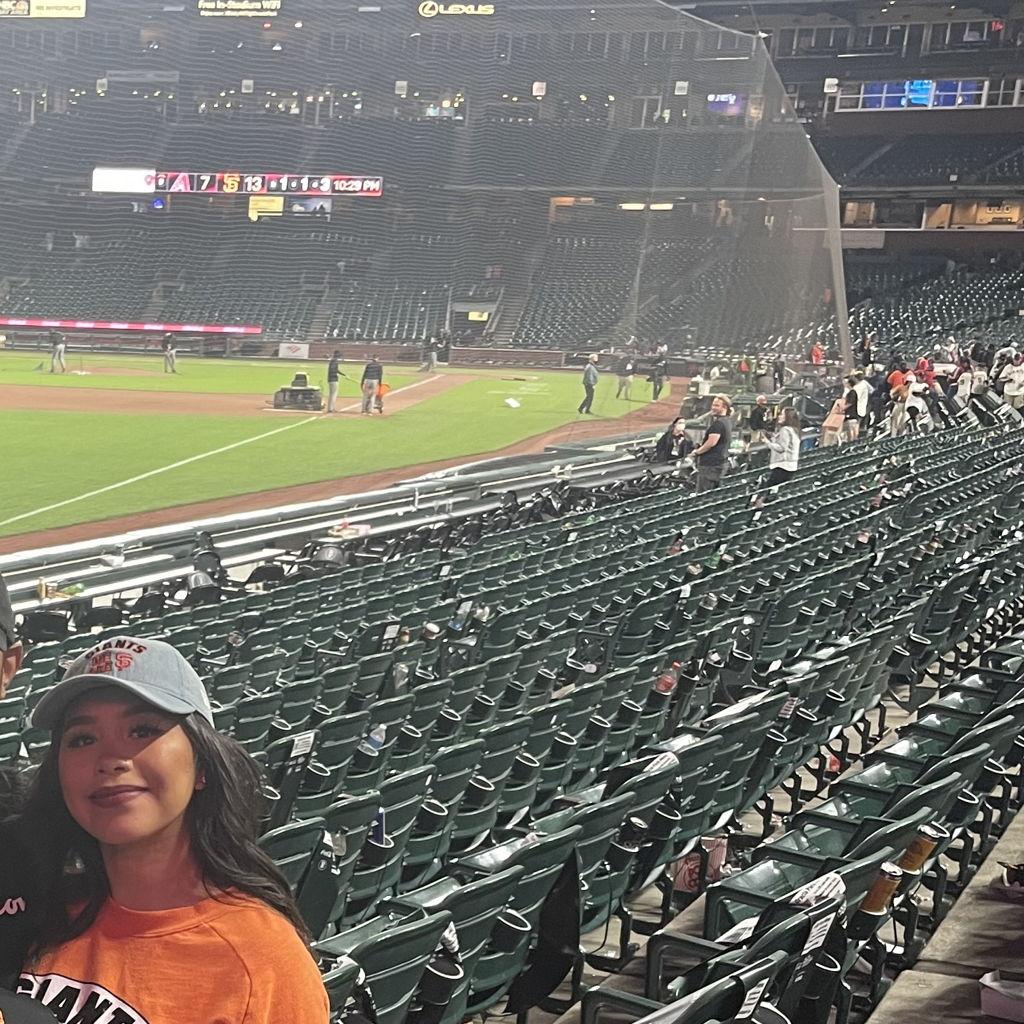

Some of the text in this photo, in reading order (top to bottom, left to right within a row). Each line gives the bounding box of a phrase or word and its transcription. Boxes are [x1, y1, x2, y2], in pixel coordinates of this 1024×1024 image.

[438, 4, 495, 15] LEXUS
[199, 175, 212, 191] 7
[244, 176, 263, 192] 13
[279, 176, 288, 191] 1
[300, 176, 309, 191] 1
[319, 177, 331, 192] 3
[363, 180, 380, 192] PM
